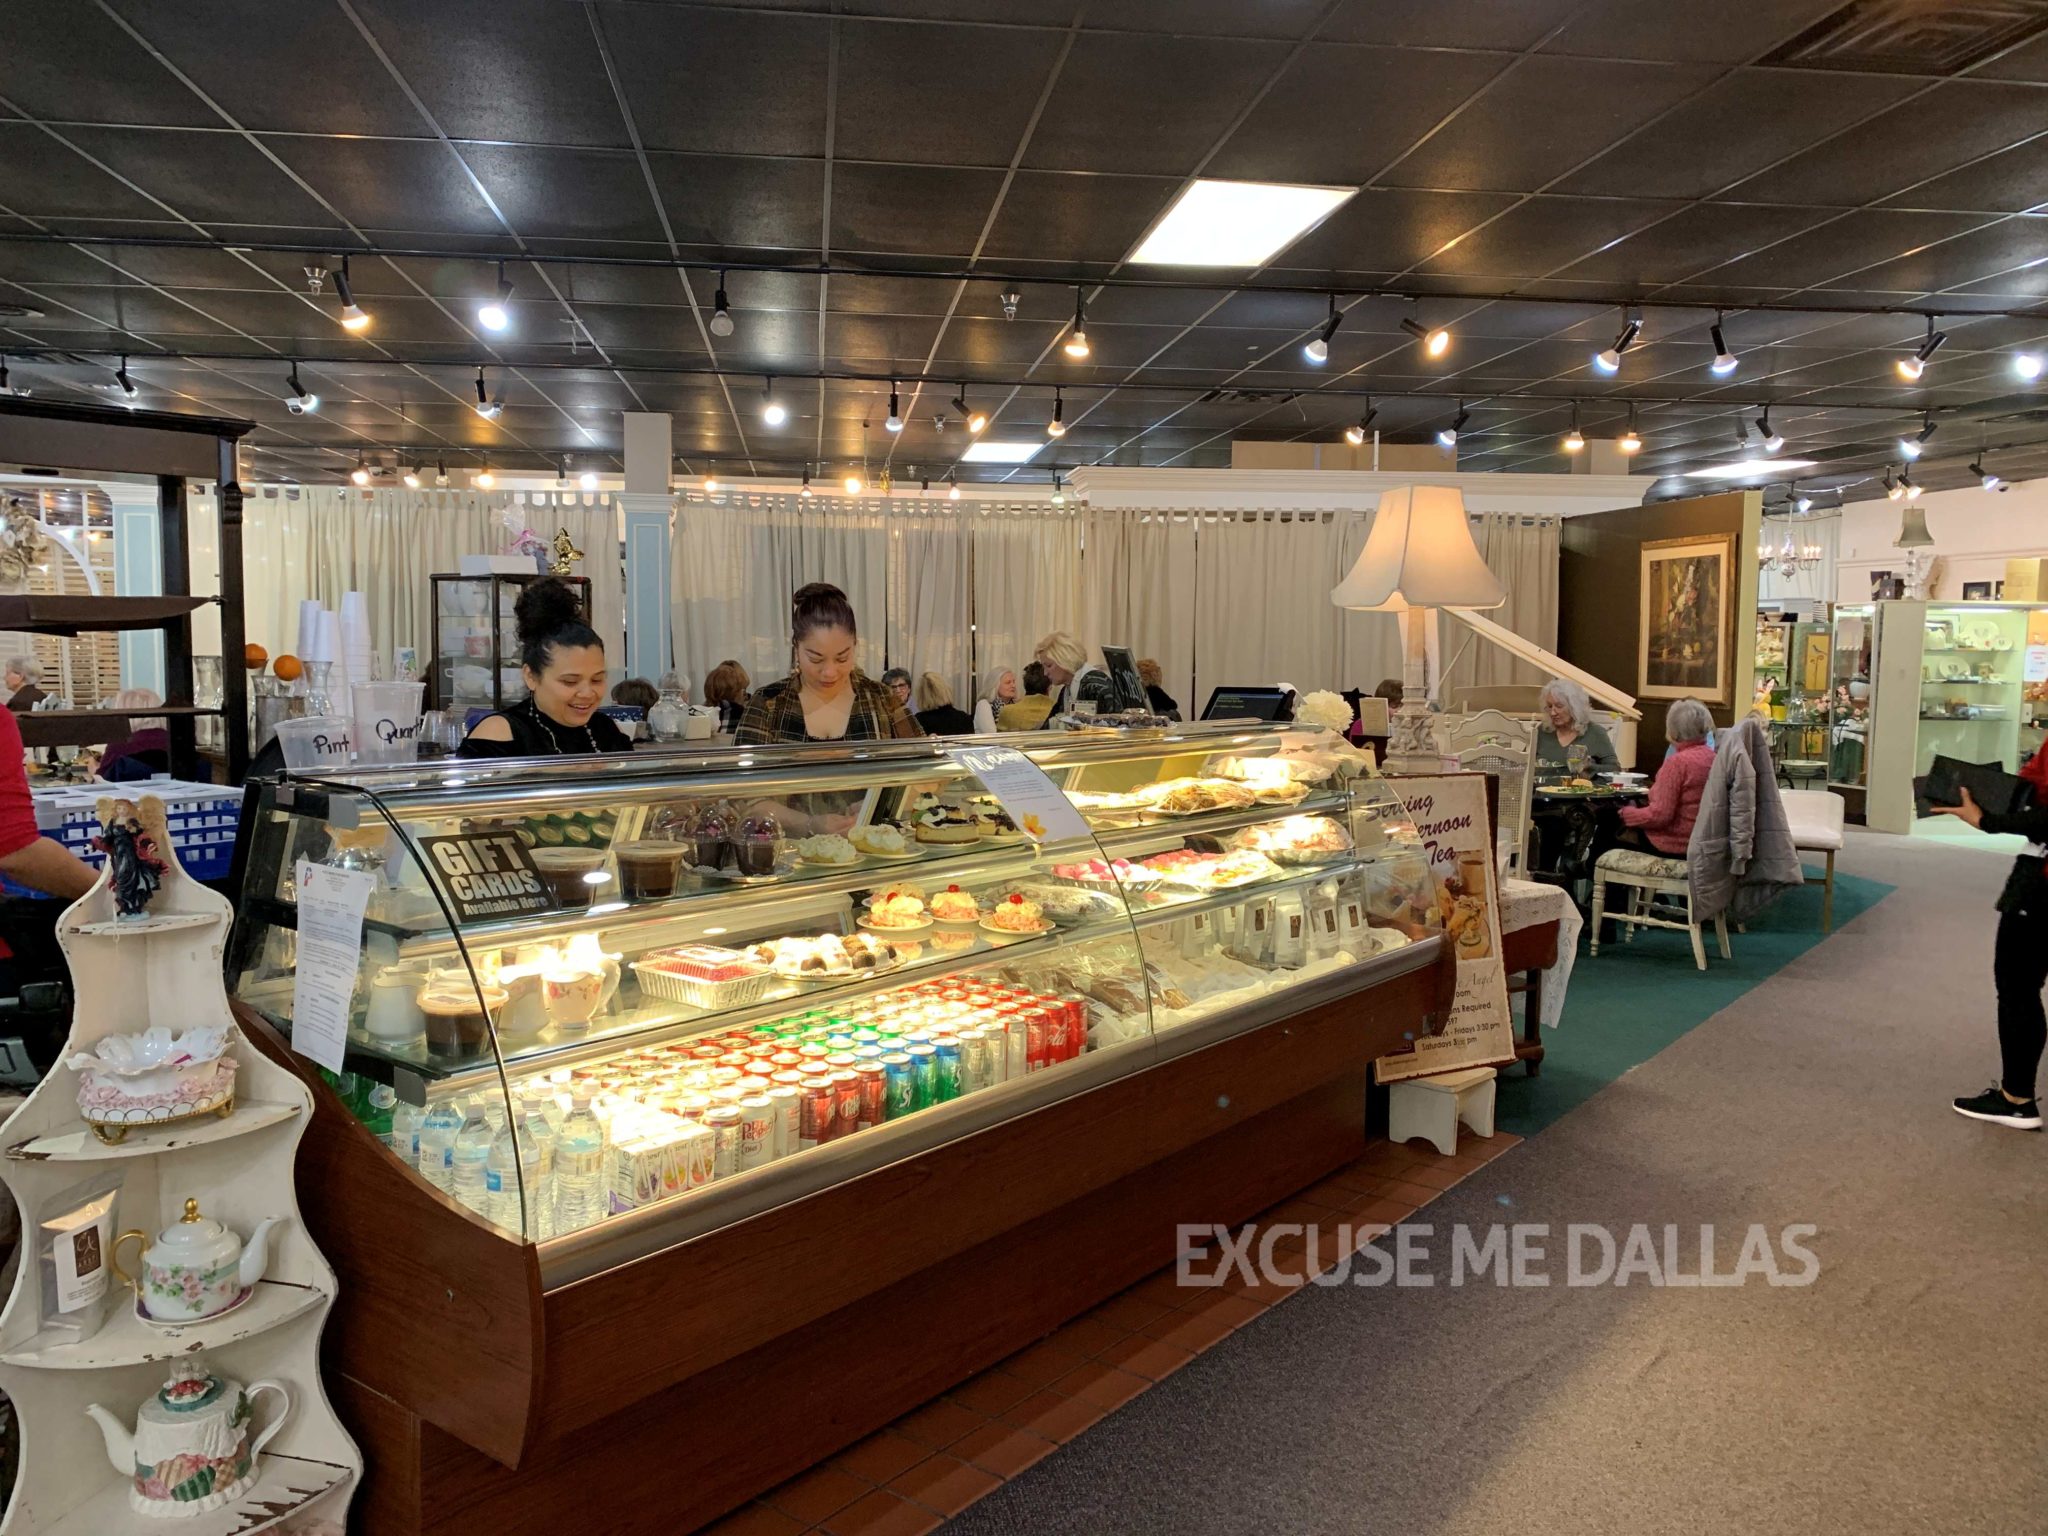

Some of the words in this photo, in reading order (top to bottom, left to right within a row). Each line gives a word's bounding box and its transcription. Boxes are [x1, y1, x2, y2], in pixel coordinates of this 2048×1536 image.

[376, 719, 421, 744] Quart
[313, 735, 349, 754] Pint
[1366, 795, 1434, 821] Serving
[432, 836, 525, 876] GIFT
[1424, 841, 1457, 865] Tea
[450, 869, 541, 901] CARDS
[463, 899, 519, 915] Available
[519, 896, 549, 909] Here
[1455, 990, 1471, 998] oom
[1461, 1001, 1491, 1014] Required
[1454, 1024, 1475, 1036] Fridays
[1421, 1040, 1452, 1051] Saturdays
